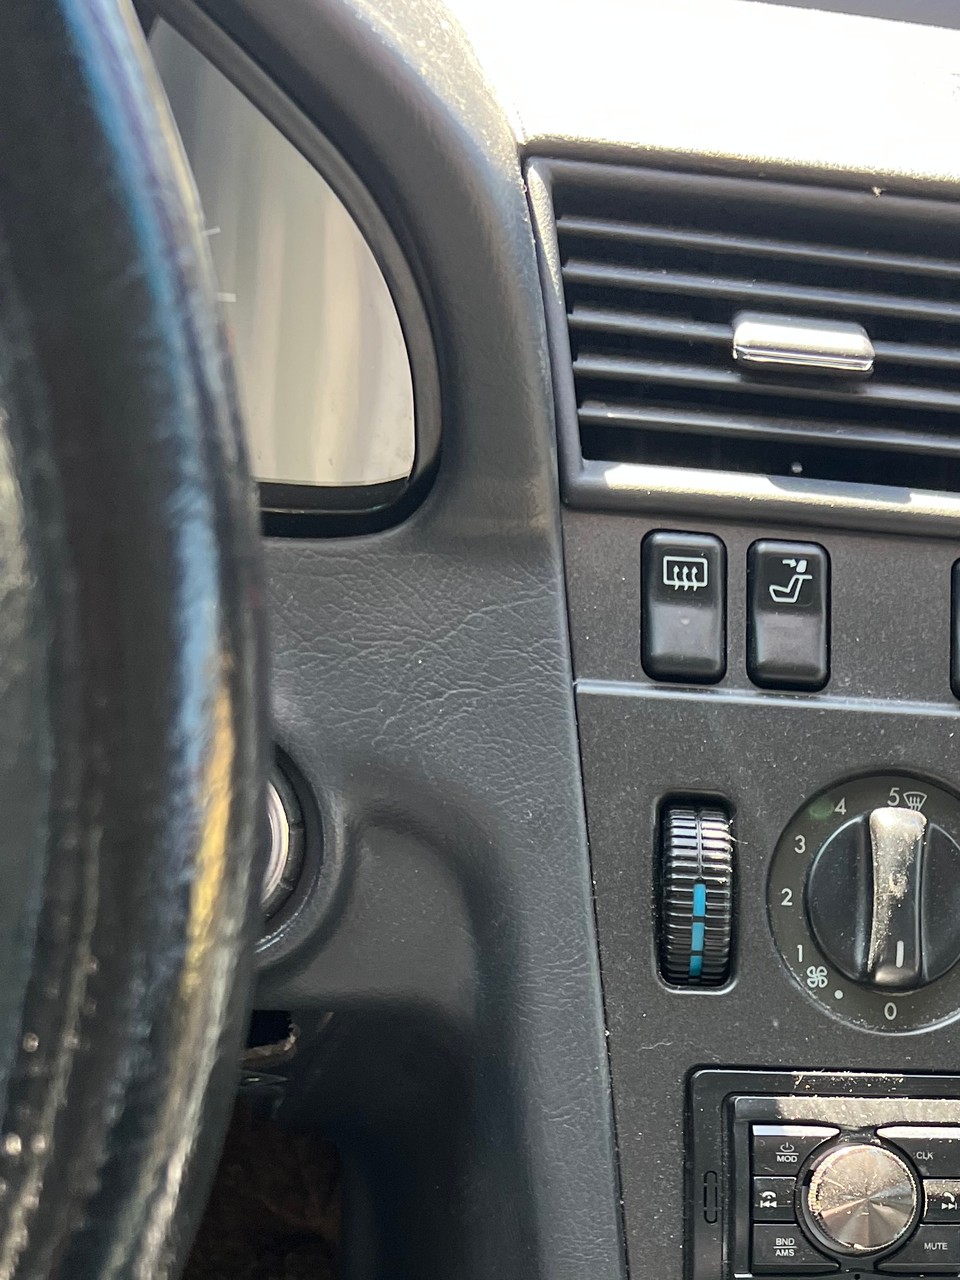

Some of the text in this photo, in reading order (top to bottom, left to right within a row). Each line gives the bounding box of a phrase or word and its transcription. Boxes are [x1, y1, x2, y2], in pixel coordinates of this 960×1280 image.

[887, 787, 900, 807] 5
[834, 797, 848, 816] 4
[794, 835, 806, 854] 3
[780, 888, 793, 907] 2
[796, 945, 804, 962] 1
[884, 1002, 897, 1021] 0
[776, 1154, 798, 1163] MOD
[916, 1151, 934, 1160] CLK
[775, 1237, 795, 1246] BND
[924, 1242, 949, 1250] MUTE
[775, 1249, 795, 1257] AMS
